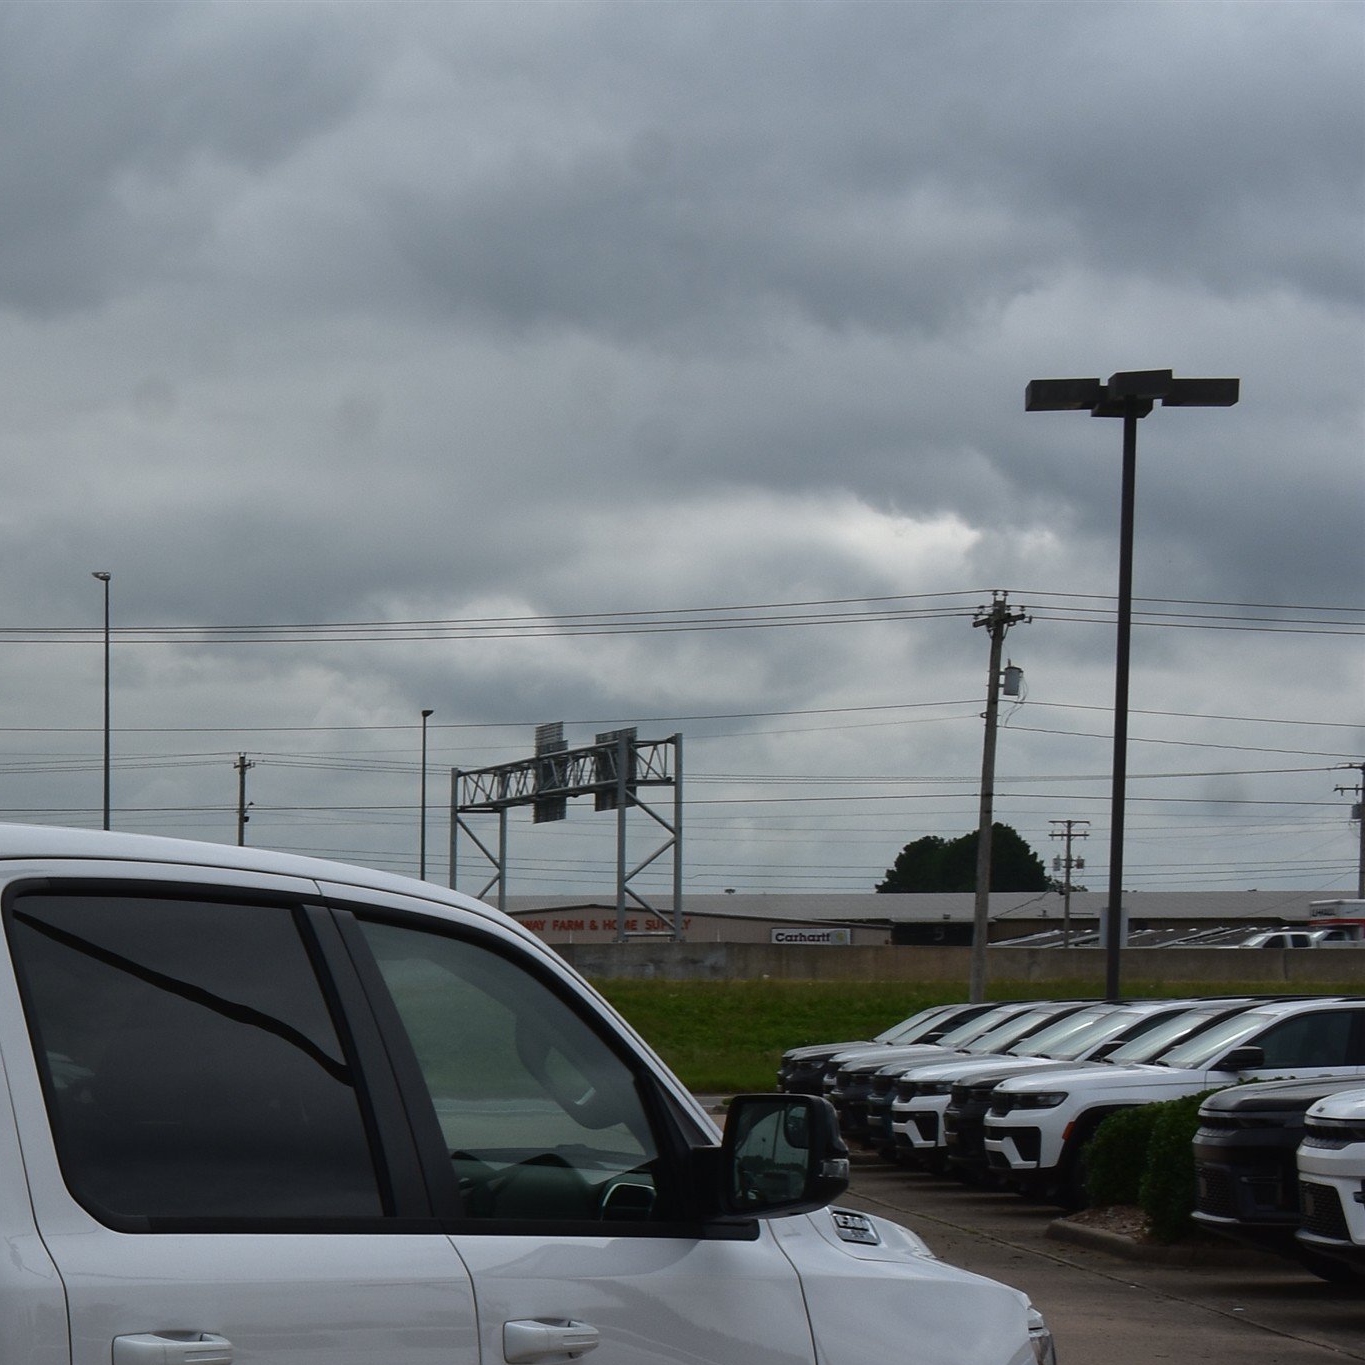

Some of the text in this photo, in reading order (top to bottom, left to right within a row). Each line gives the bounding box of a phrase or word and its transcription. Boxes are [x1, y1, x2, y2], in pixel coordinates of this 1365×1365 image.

[552, 919, 584, 931] FARM
[589, 919, 599, 930] &
[644, 919, 691, 931] SUPY
[775, 932, 831, 942] Carhartt
